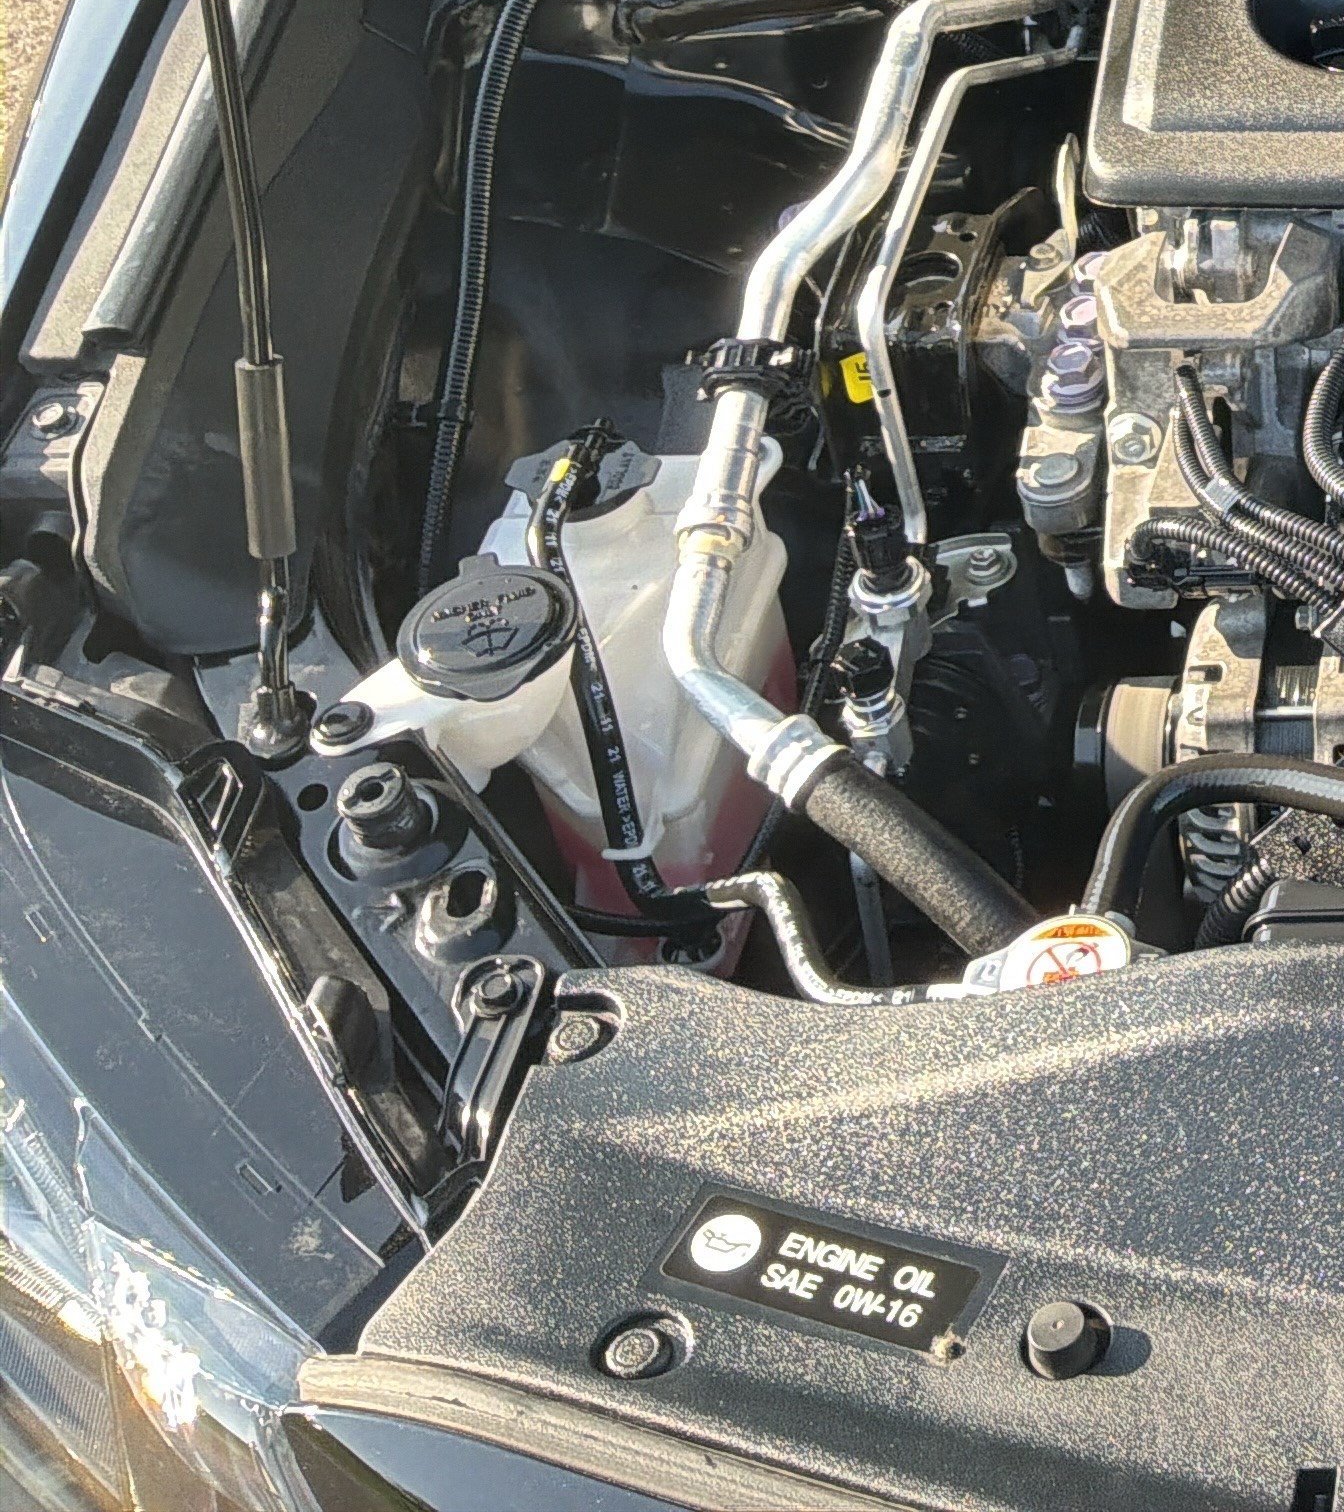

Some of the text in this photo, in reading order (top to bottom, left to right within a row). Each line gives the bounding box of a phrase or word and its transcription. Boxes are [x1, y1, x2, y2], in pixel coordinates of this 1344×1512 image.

[761, 1263, 924, 1329] SAE 0W-16
[778, 1232, 938, 1300] ENGINE OIL
